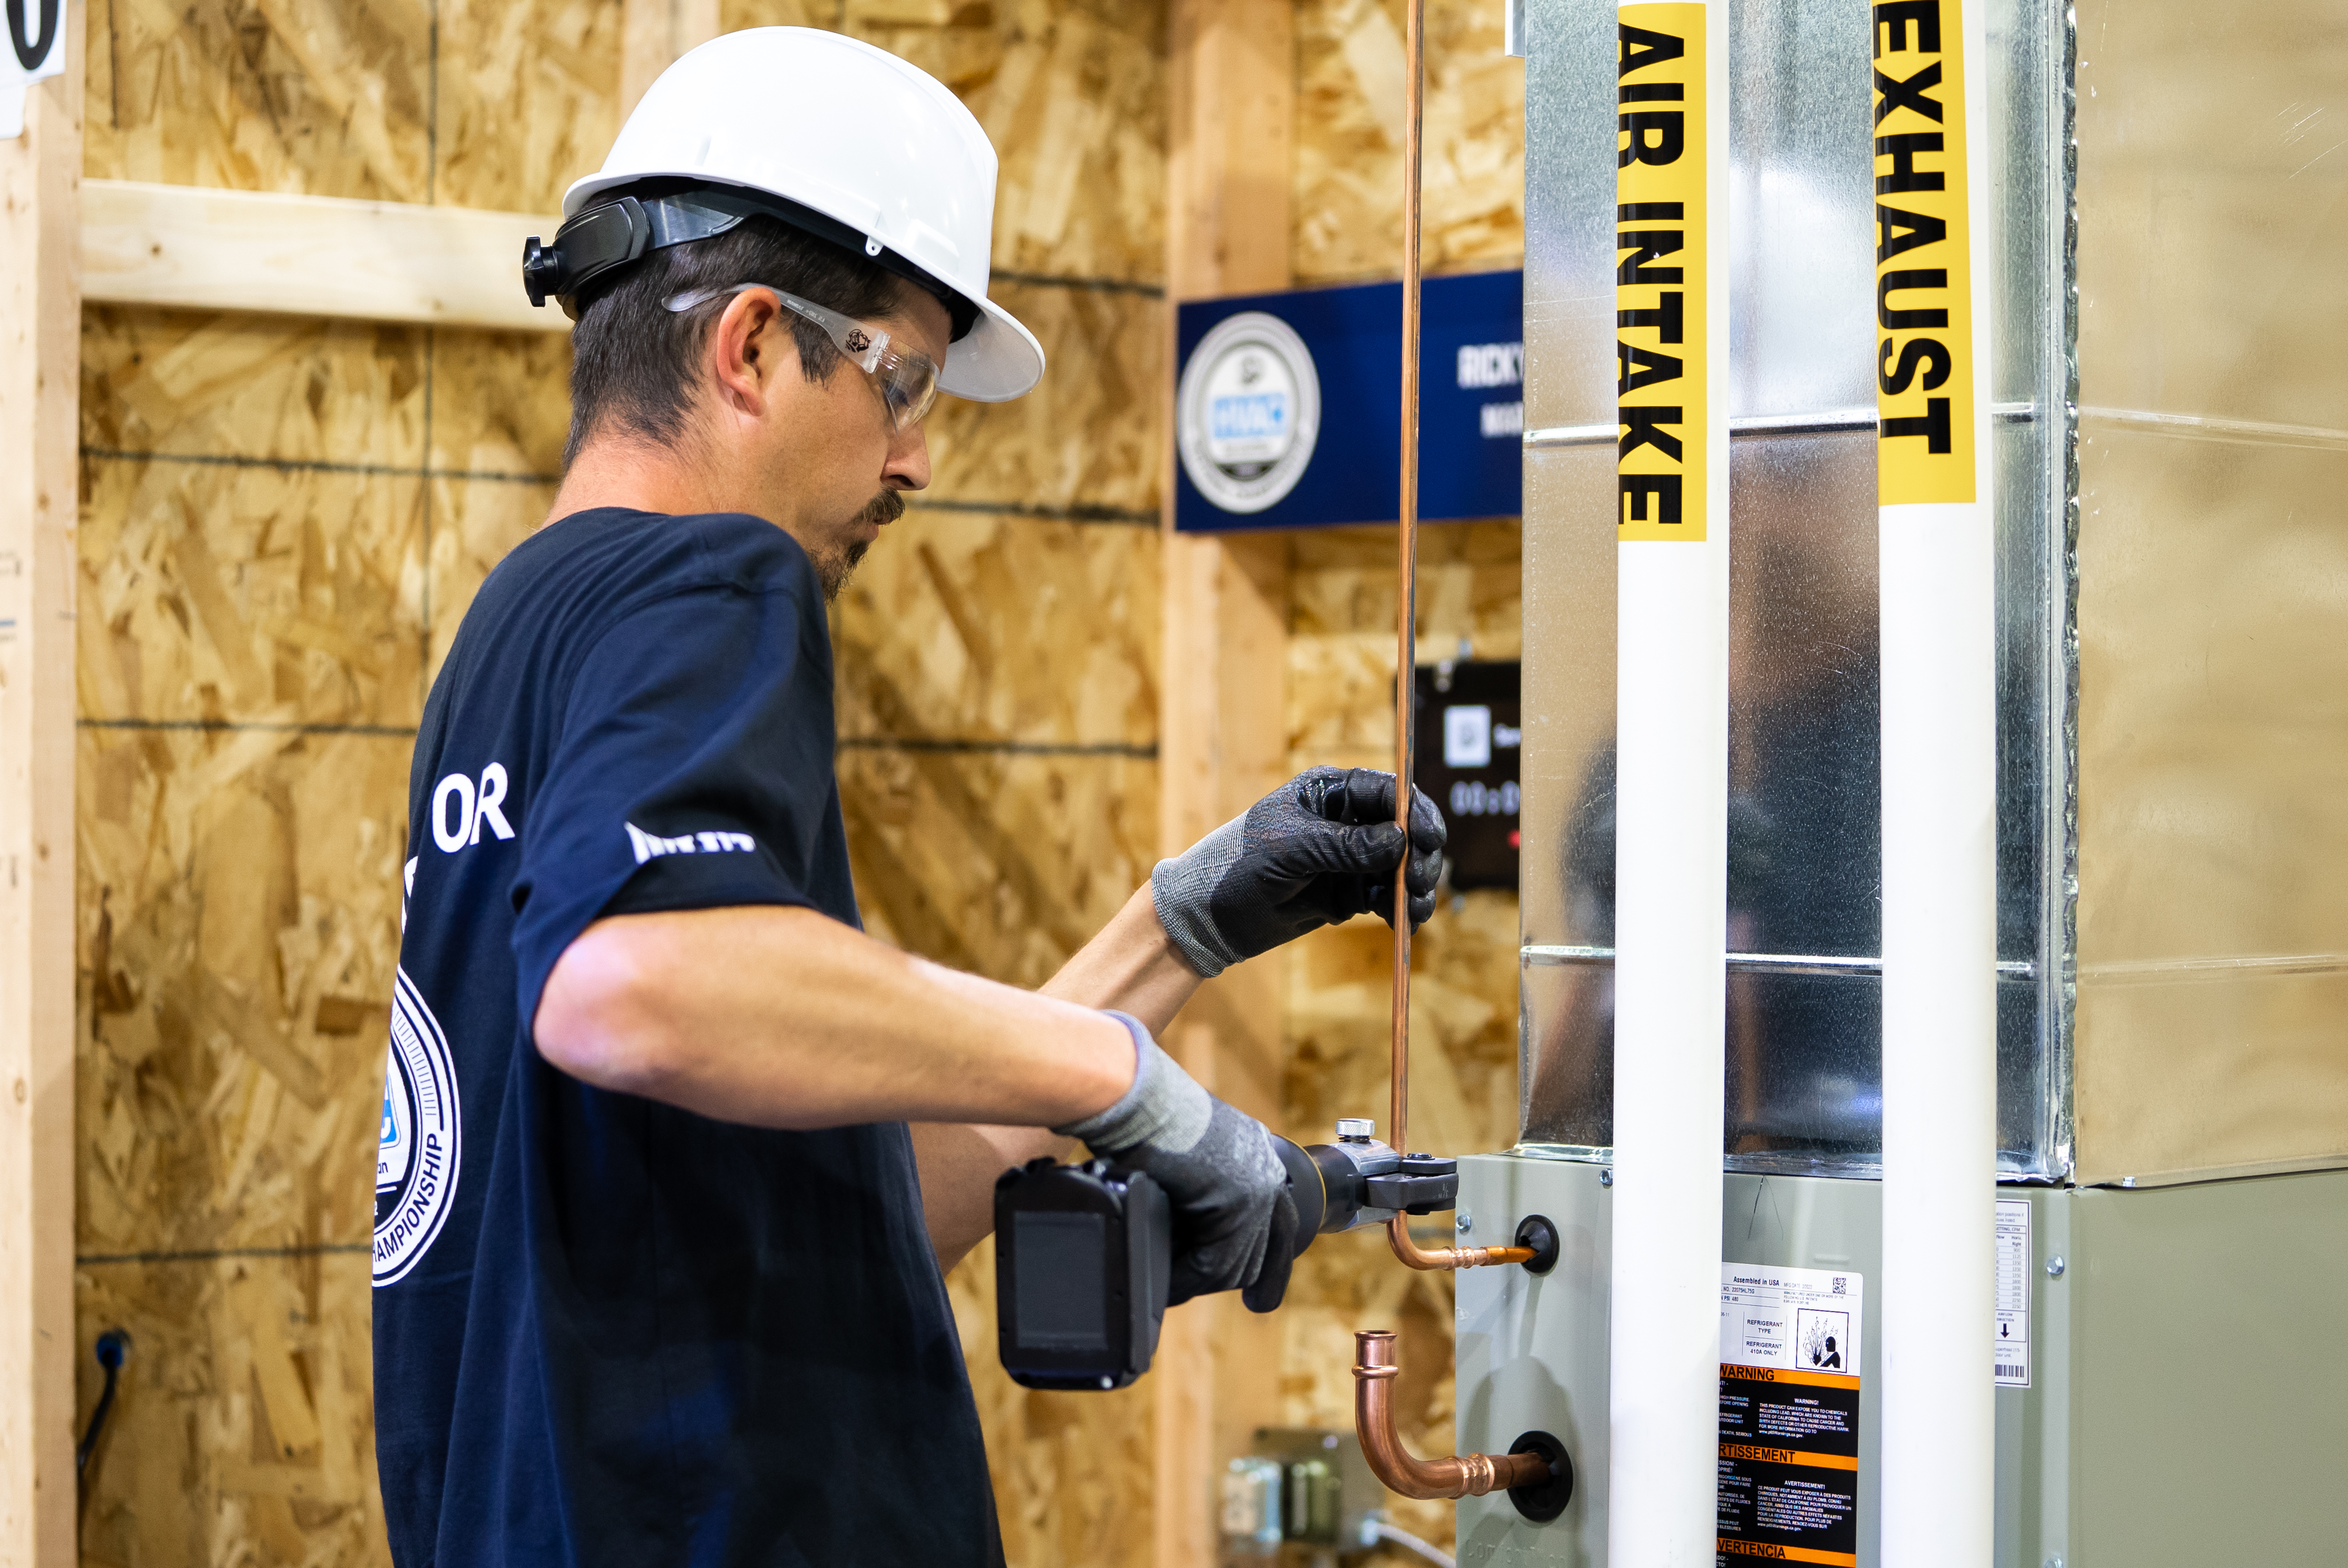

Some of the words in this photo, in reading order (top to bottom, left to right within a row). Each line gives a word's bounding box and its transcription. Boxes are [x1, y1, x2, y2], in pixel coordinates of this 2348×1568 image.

[1618, 22, 1684, 167] AIR
[1873, 0, 1952, 454] EXHAUST
[1617, 201, 1683, 525] INTAKE
[433, 762, 515, 853] OR
[1734, 1276, 1761, 1284] Assembled
[1747, 1319, 1782, 1328] REFRIGERANT
[1746, 1341, 1782, 1349] REFRIGERANT
[1720, 1364, 1774, 1381] WARNING
[1795, 1397, 1819, 1405] WARNING!
[1719, 1444, 1795, 1463] RTISSEMENT
[1784, 1479, 1825, 1489] AVERTISSEMENT!
[1717, 1539, 1786, 1559] VERTENCIA
